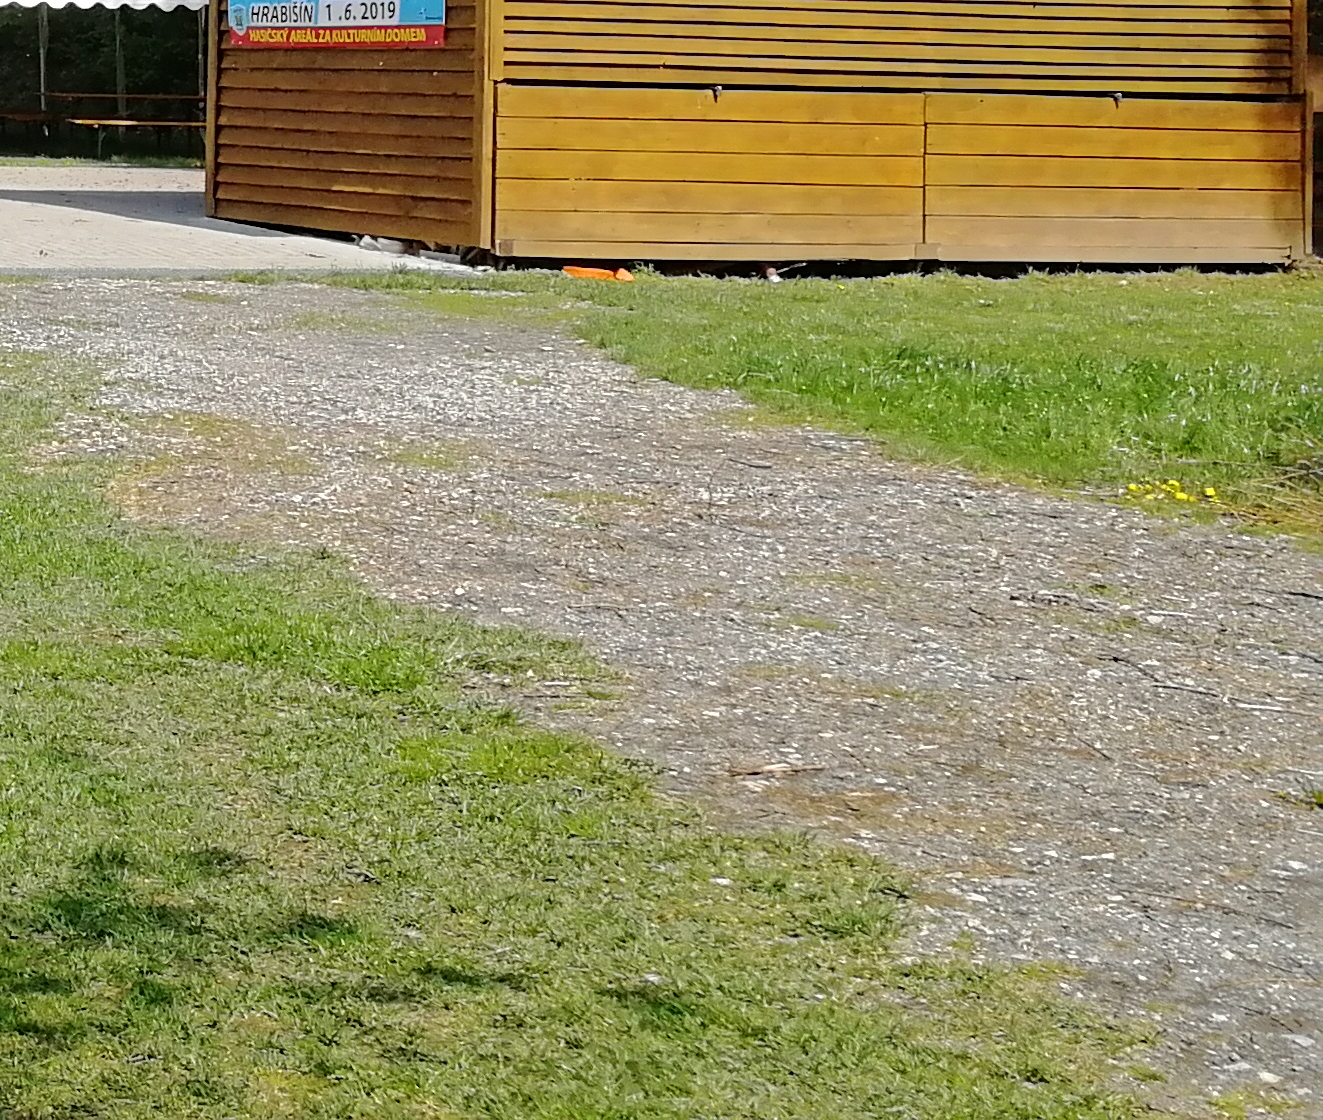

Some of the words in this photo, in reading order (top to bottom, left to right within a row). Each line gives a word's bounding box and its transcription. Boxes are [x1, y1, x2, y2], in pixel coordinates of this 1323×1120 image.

[251, 0, 314, 23] HRABIŠÍN
[249, 28, 288, 42] HASIČSKÝ
[289, 28, 318, 42] AREÁL
[318, 28, 331, 41] ZA
[332, 27, 385, 42] KULTURNÍM
[385, 28, 426, 42] DOMEM
